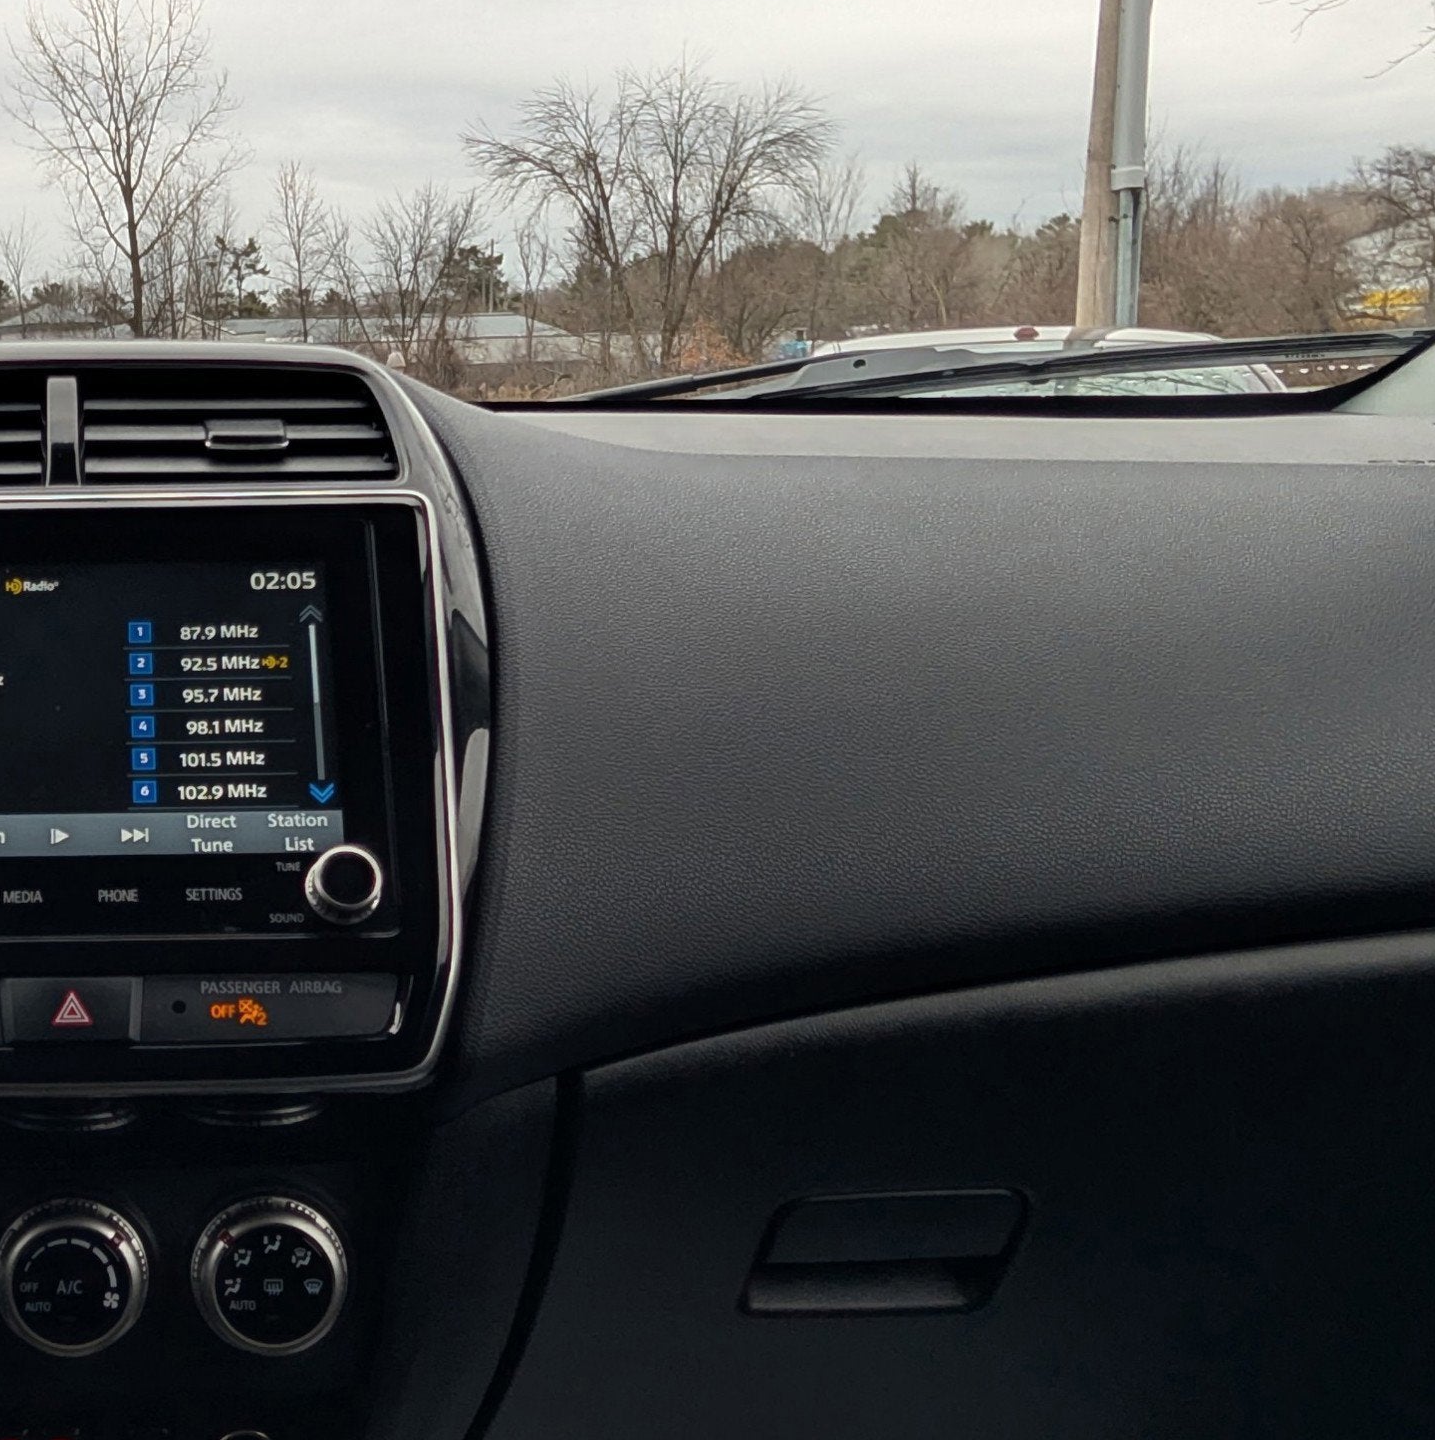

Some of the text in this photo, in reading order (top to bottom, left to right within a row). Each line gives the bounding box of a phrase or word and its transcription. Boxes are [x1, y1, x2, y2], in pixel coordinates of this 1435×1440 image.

[249, 571, 317, 590] 02:05
[180, 626, 216, 640] 87.9
[220, 624, 259, 639] MHz
[180, 657, 218, 672] 92.5
[221, 655, 260, 670] MHz
[182, 688, 218, 703] 95.7
[222, 687, 262, 702] MHz
[186, 720, 221, 735] 98.1
[224, 719, 264, 733] MHz
[179, 752, 222, 767] 101.5
[226, 751, 265, 766] MHz
[177, 785, 224, 800] 102.9
[227, 784, 268, 799] MHz
[185, 813, 238, 830] Direct
[267, 812, 329, 829] Station
[191, 838, 233, 854] Tune
[284, 836, 316, 852] List
[274, 861, 302, 873] TUNE
[1, 889, 44, 905] MEDIA
[96, 888, 140, 903] PHONE
[184, 886, 244, 902] SETTINGS
[268, 912, 306, 925] SOUND
[199, 979, 344, 996] PASSENGER AIRBAG
[209, 1002, 236, 1020] OFF
[18, 1281, 40, 1294] OFF
[54, 1278, 84, 1297] A/C
[23, 1301, 52, 1314] AUTO
[228, 1299, 257, 1313] AUTO
